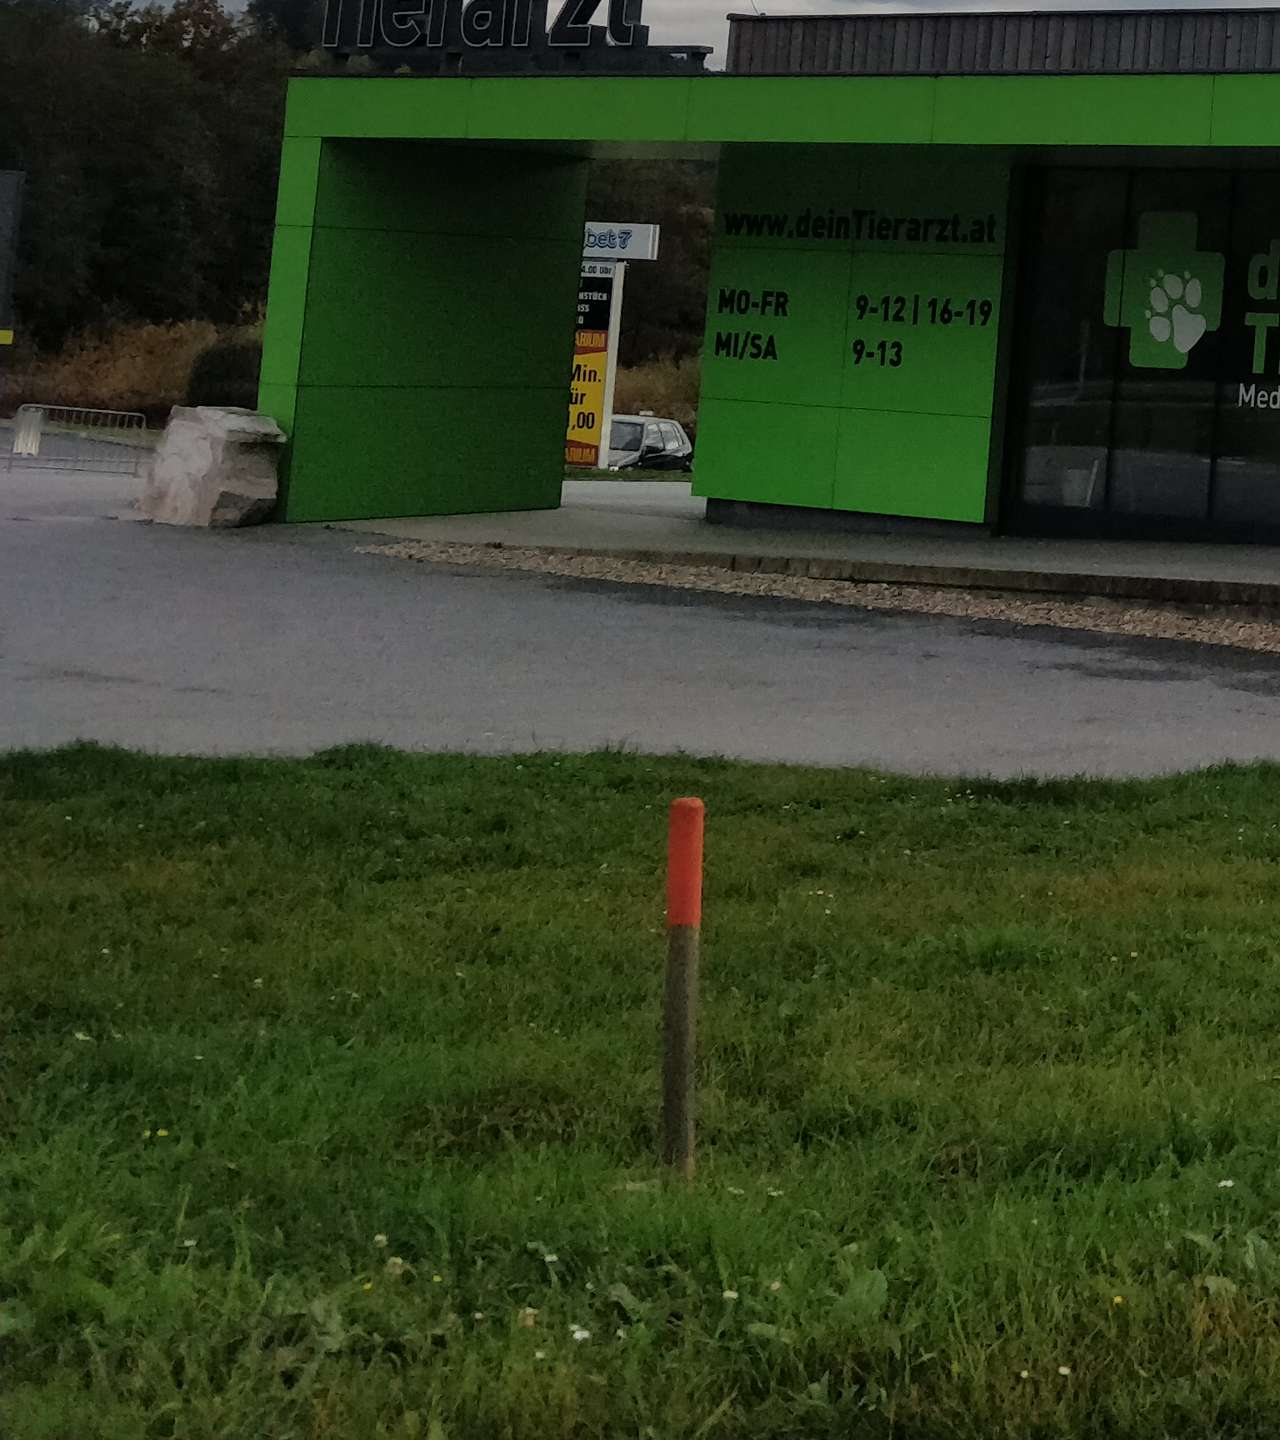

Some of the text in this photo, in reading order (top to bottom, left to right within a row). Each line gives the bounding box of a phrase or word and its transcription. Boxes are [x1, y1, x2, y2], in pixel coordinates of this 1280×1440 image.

[723, 209, 998, 244] www.deinTierarzt.at
[717, 288, 789, 317] MO-FR
[855, 294, 906, 323] 9-12
[927, 297, 993, 327] 16-19
[714, 331, 904, 368] MI/SA 9-13
